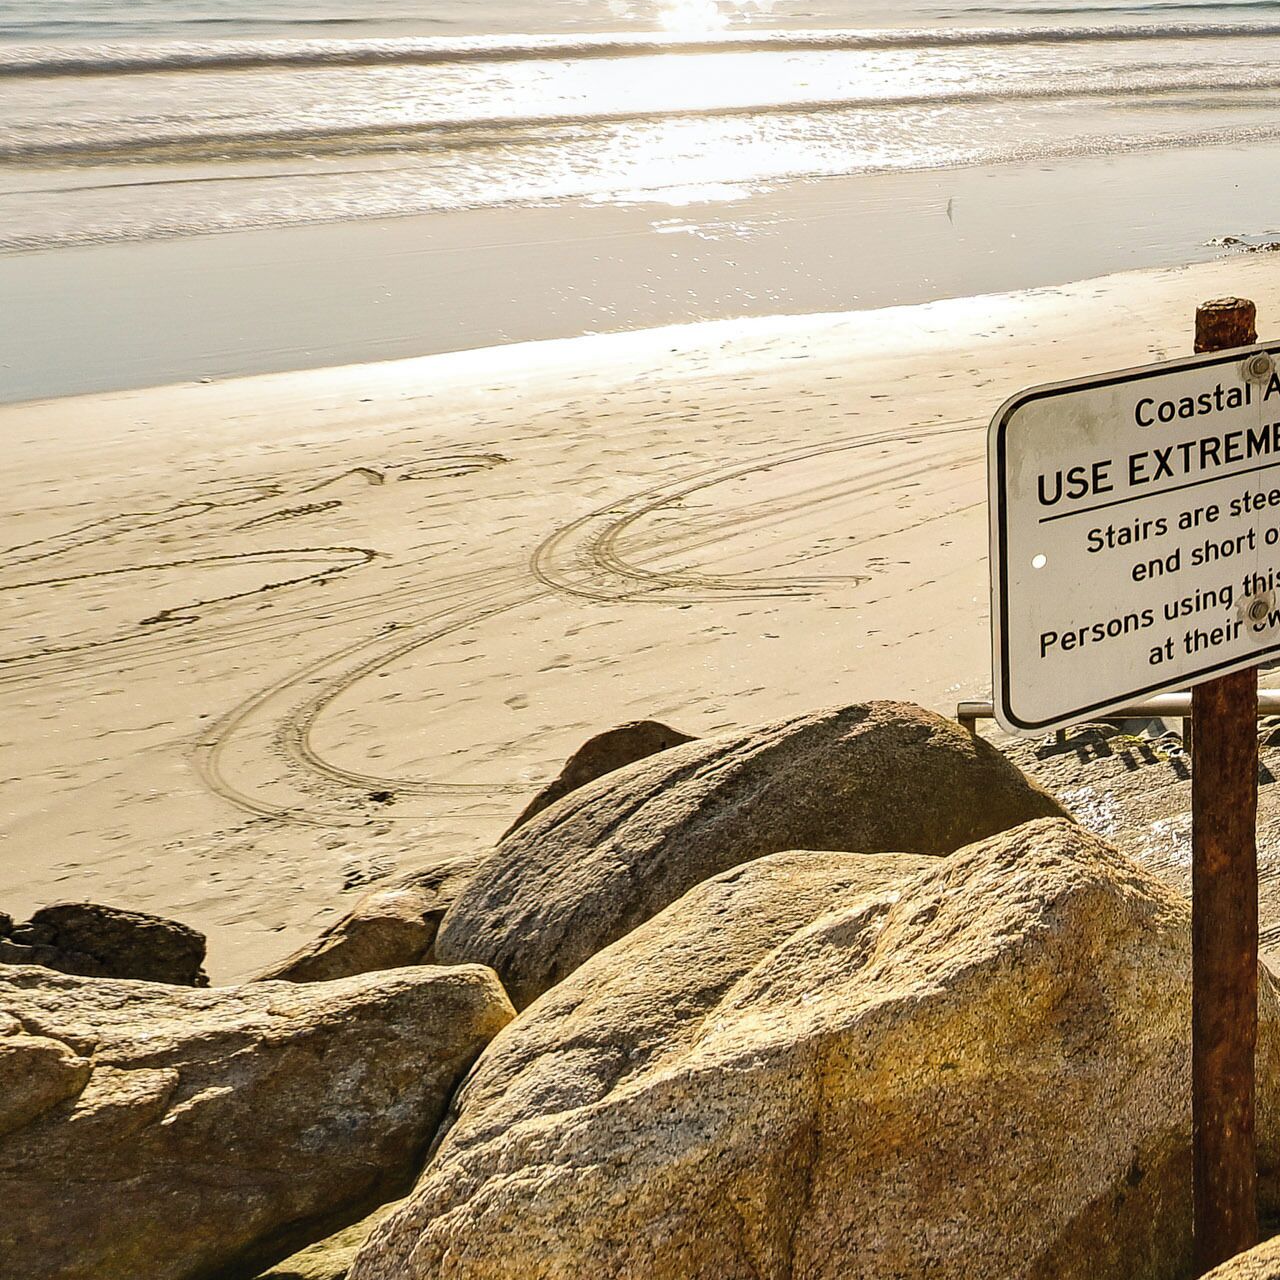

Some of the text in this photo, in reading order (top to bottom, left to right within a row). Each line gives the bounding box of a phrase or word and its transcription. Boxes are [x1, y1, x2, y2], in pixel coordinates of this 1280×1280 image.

[1135, 383, 1251, 427] Coastal
[1038, 460, 1113, 505] USE
[1087, 517, 1167, 553] Stairs
[1178, 507, 1219, 529] are
[1131, 555, 1181, 582] end
[1191, 535, 1256, 565] short
[1040, 612, 1154, 657] Persons
[1165, 585, 1233, 620] using
[1148, 641, 1174, 665] at
[1184, 621, 1243, 653] their
